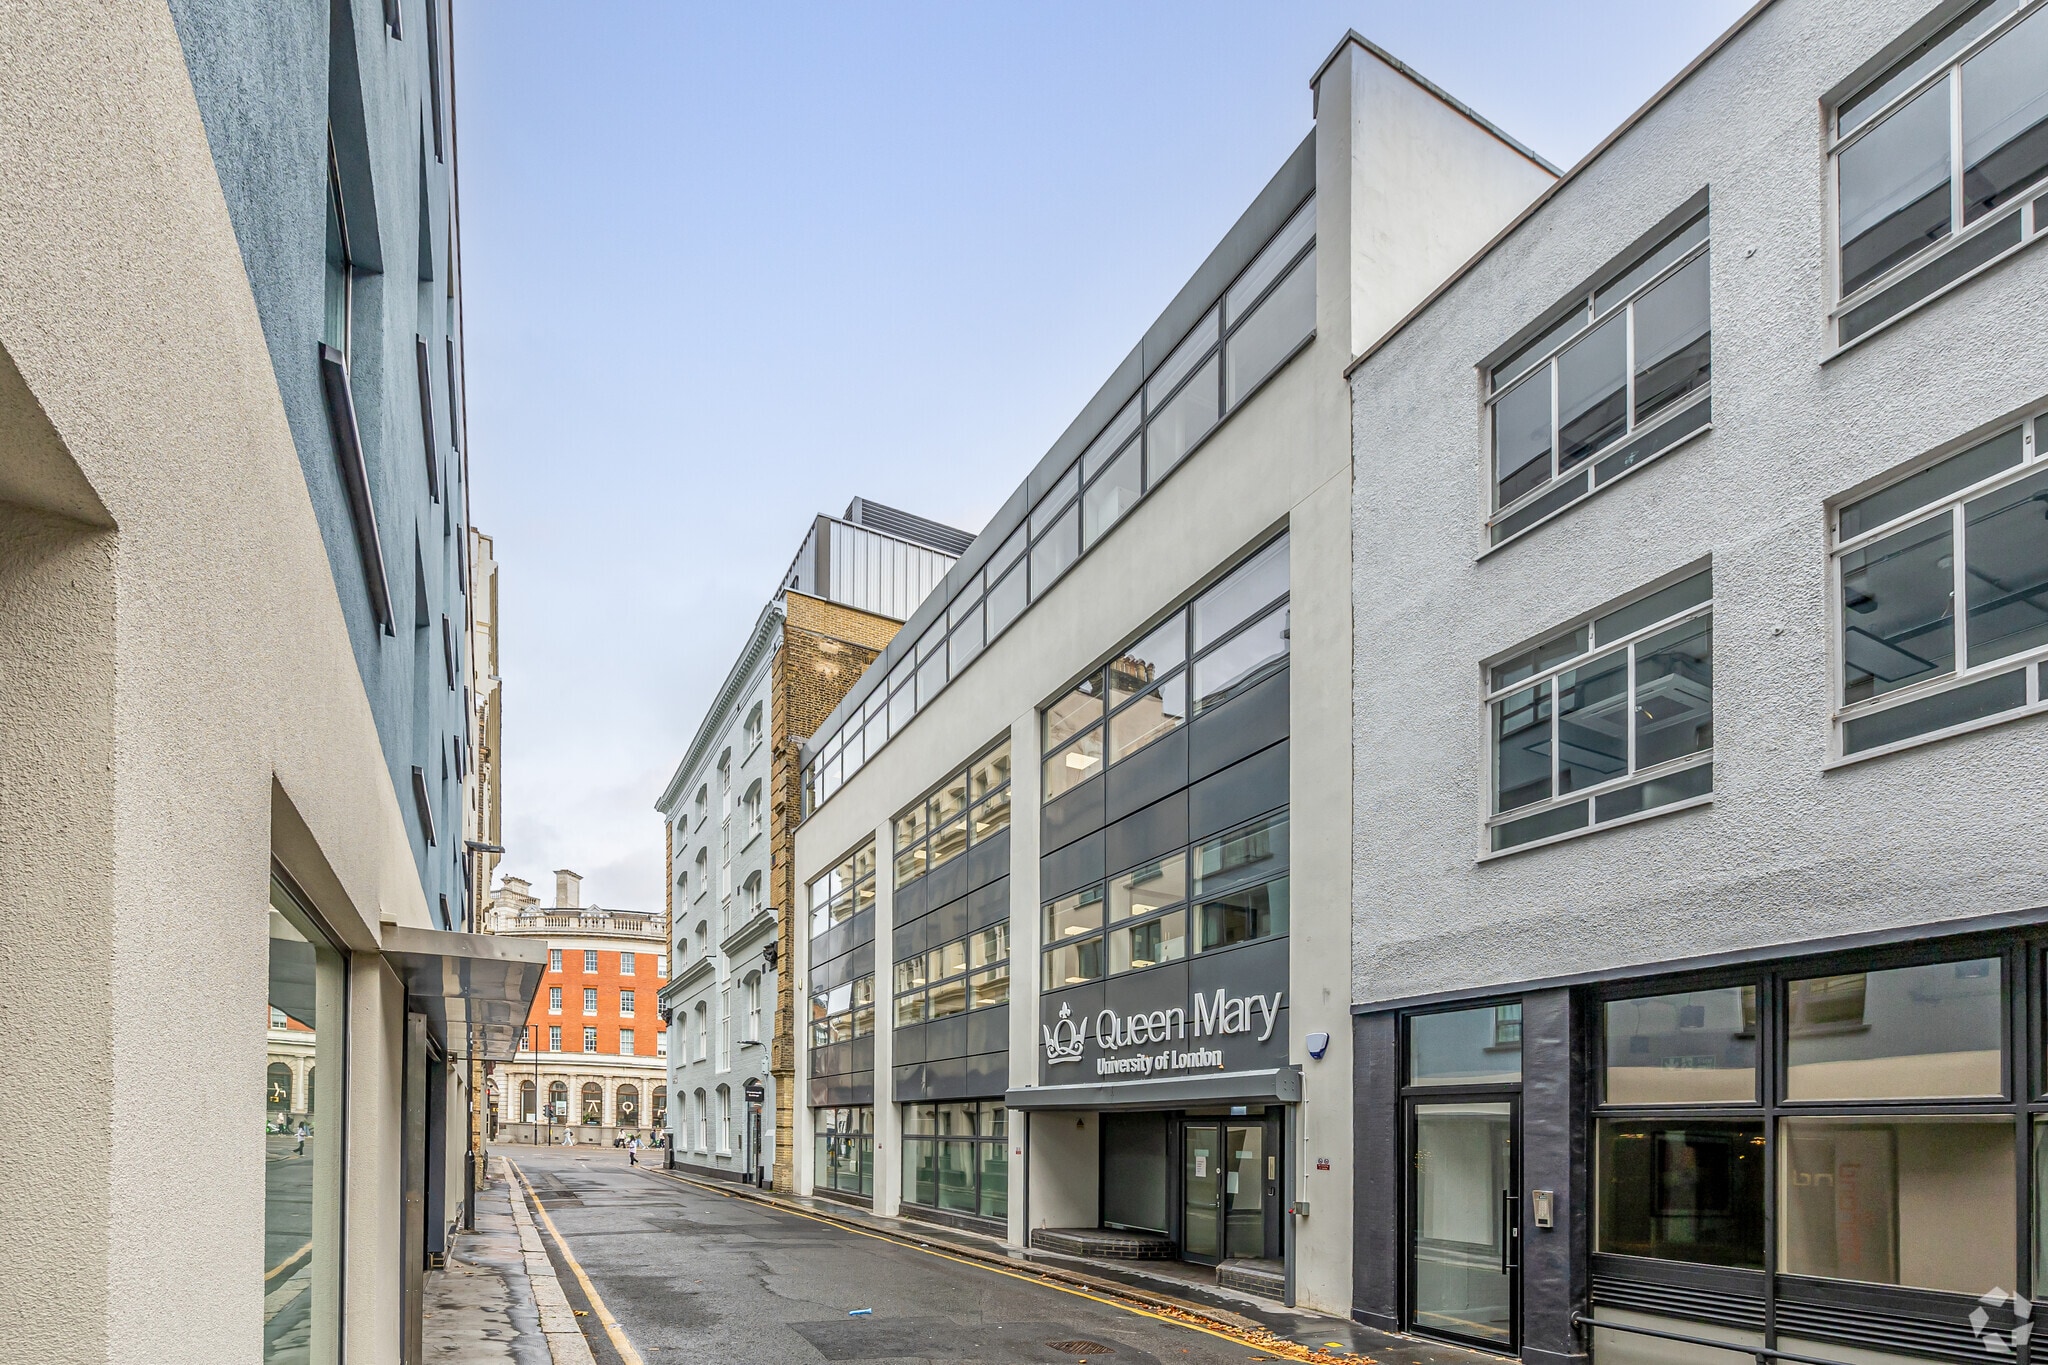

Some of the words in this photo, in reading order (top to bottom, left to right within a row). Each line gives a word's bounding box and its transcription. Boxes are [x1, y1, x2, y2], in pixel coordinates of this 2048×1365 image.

[1096, 1008, 1186, 1050] Queen
[1194, 988, 1283, 1042] Mary
[1096, 1053, 1154, 1076] University
[1154, 1050, 1170, 1070] of
[1171, 1047, 1222, 1069] London
